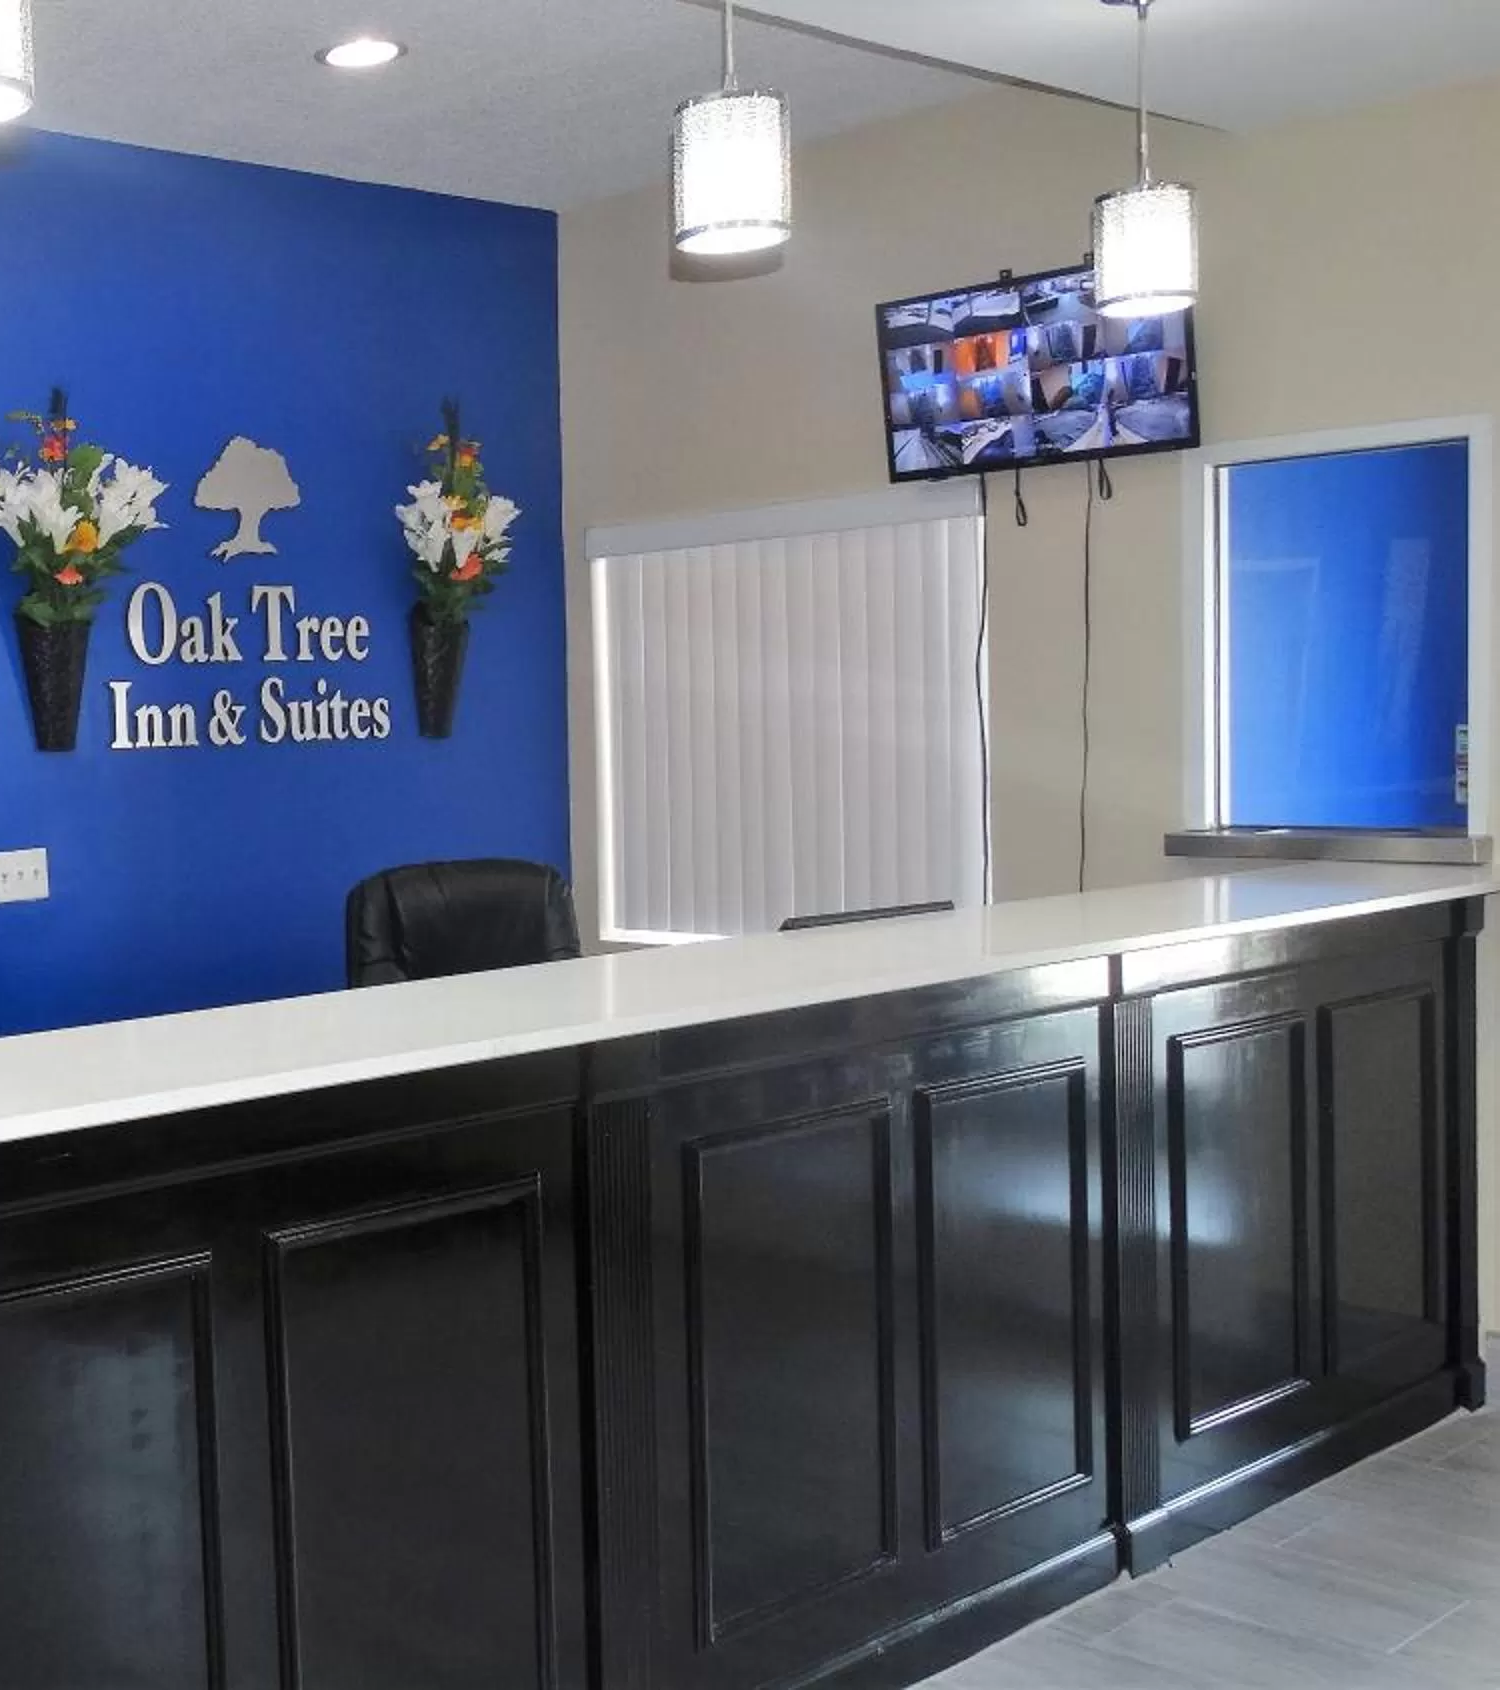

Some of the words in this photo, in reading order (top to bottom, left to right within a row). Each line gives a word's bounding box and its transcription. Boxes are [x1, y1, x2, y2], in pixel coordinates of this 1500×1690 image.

[128, 581, 243, 665] Oak
[251, 584, 370, 662] Tree
[109, 680, 199, 750] Inn
[208, 689, 248, 746] &
[260, 676, 391, 744] Suites
